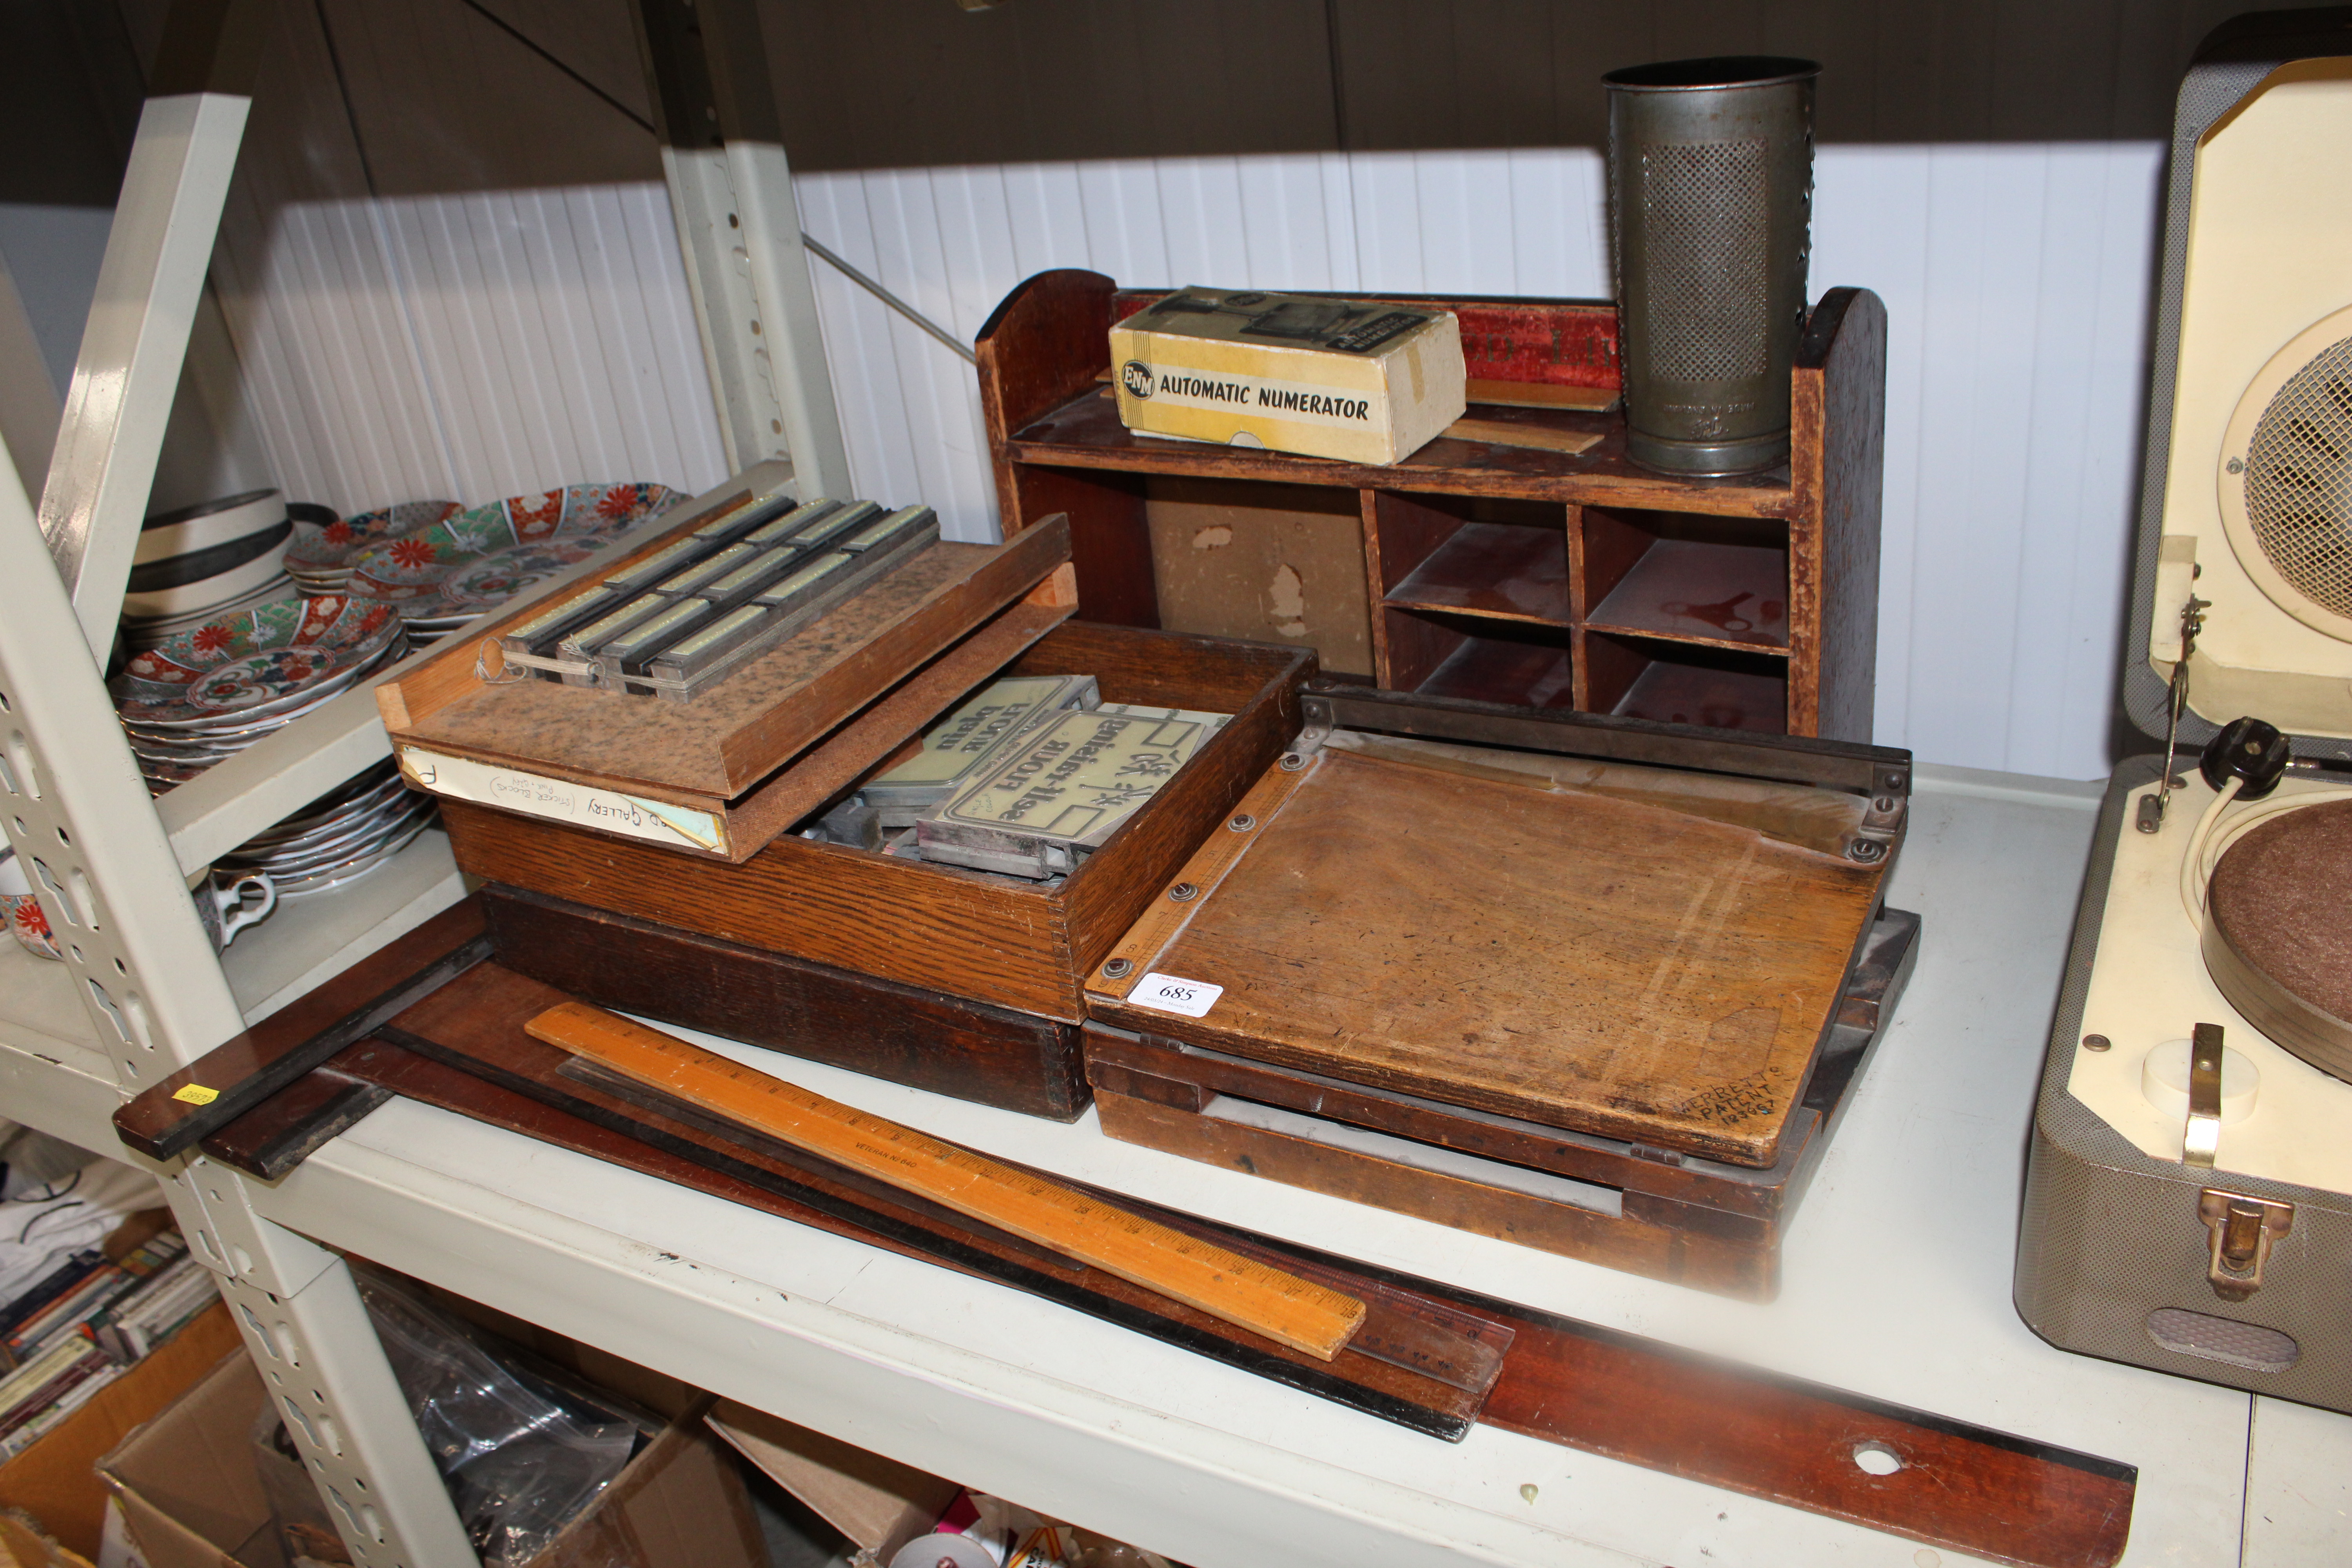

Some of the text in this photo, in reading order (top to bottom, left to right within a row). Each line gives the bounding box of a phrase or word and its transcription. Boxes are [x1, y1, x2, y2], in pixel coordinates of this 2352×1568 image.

[1124, 365, 1154, 396] ENM
[1160, 374, 1250, 404] AUTOMATIC
[1259, 387, 1368, 421] NUMERATOR
[588, 798, 642, 827] GALLERY
[1126, 944, 1137, 953] 8
[1160, 985, 1198, 1001] 685
[1700, 1084, 1773, 1120] PATENT
[855, 1142, 889, 1158] VETERAN
[900, 1159, 917, 1168] 640
[1340, 1307, 1357, 1318] 18
